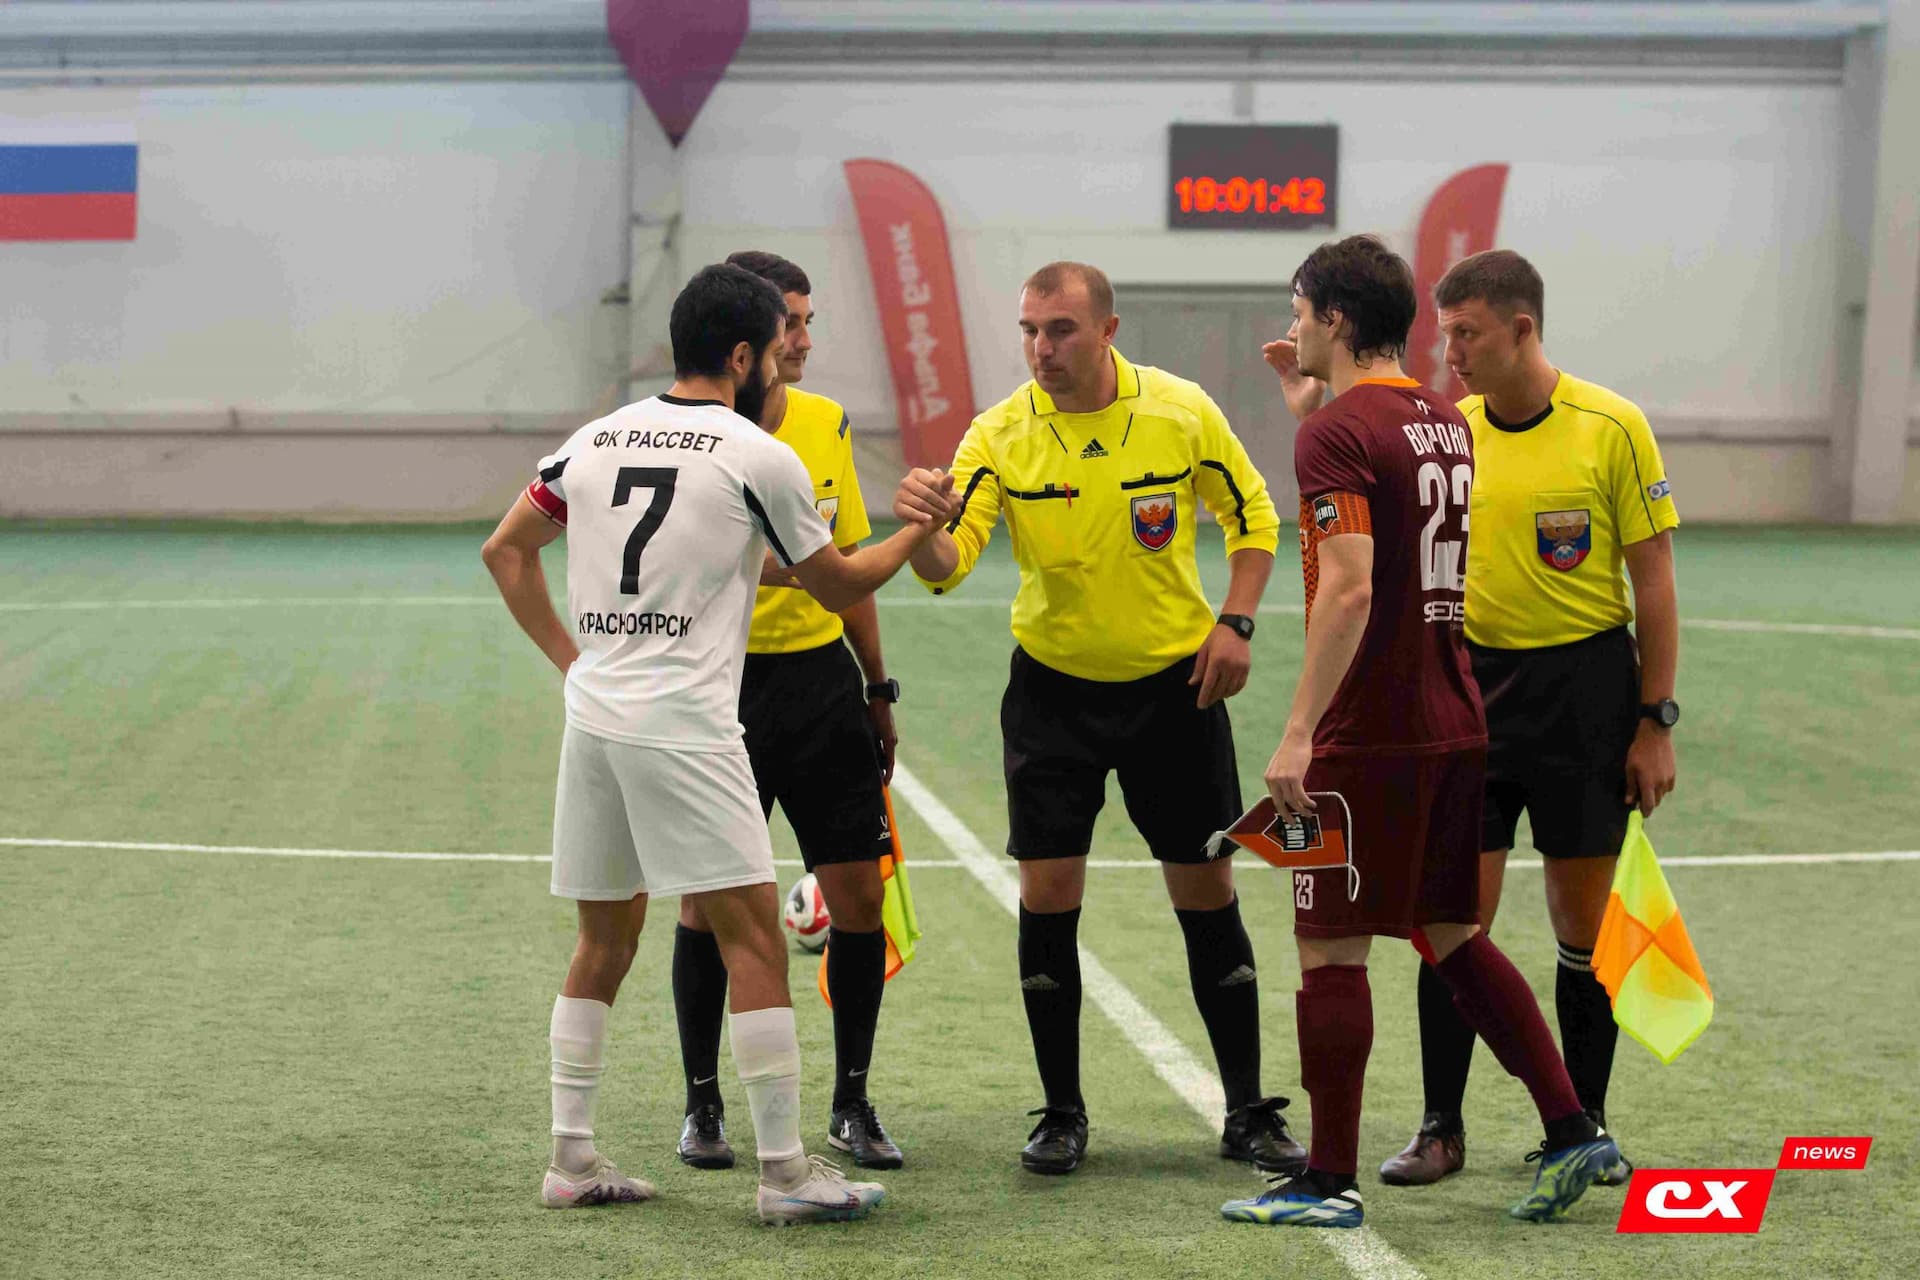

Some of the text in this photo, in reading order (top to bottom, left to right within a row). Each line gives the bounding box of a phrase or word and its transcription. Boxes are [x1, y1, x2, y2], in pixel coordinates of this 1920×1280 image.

[1174, 176, 1325, 214] 19:01:42
[594, 430, 723, 453] ФК РАССВЕТ
[611, 466, 679, 595] 7
[1418, 462, 1472, 591] 23
[579, 612, 693, 638] КРАСНОЯРСК
[1295, 872, 1314, 910] 23
